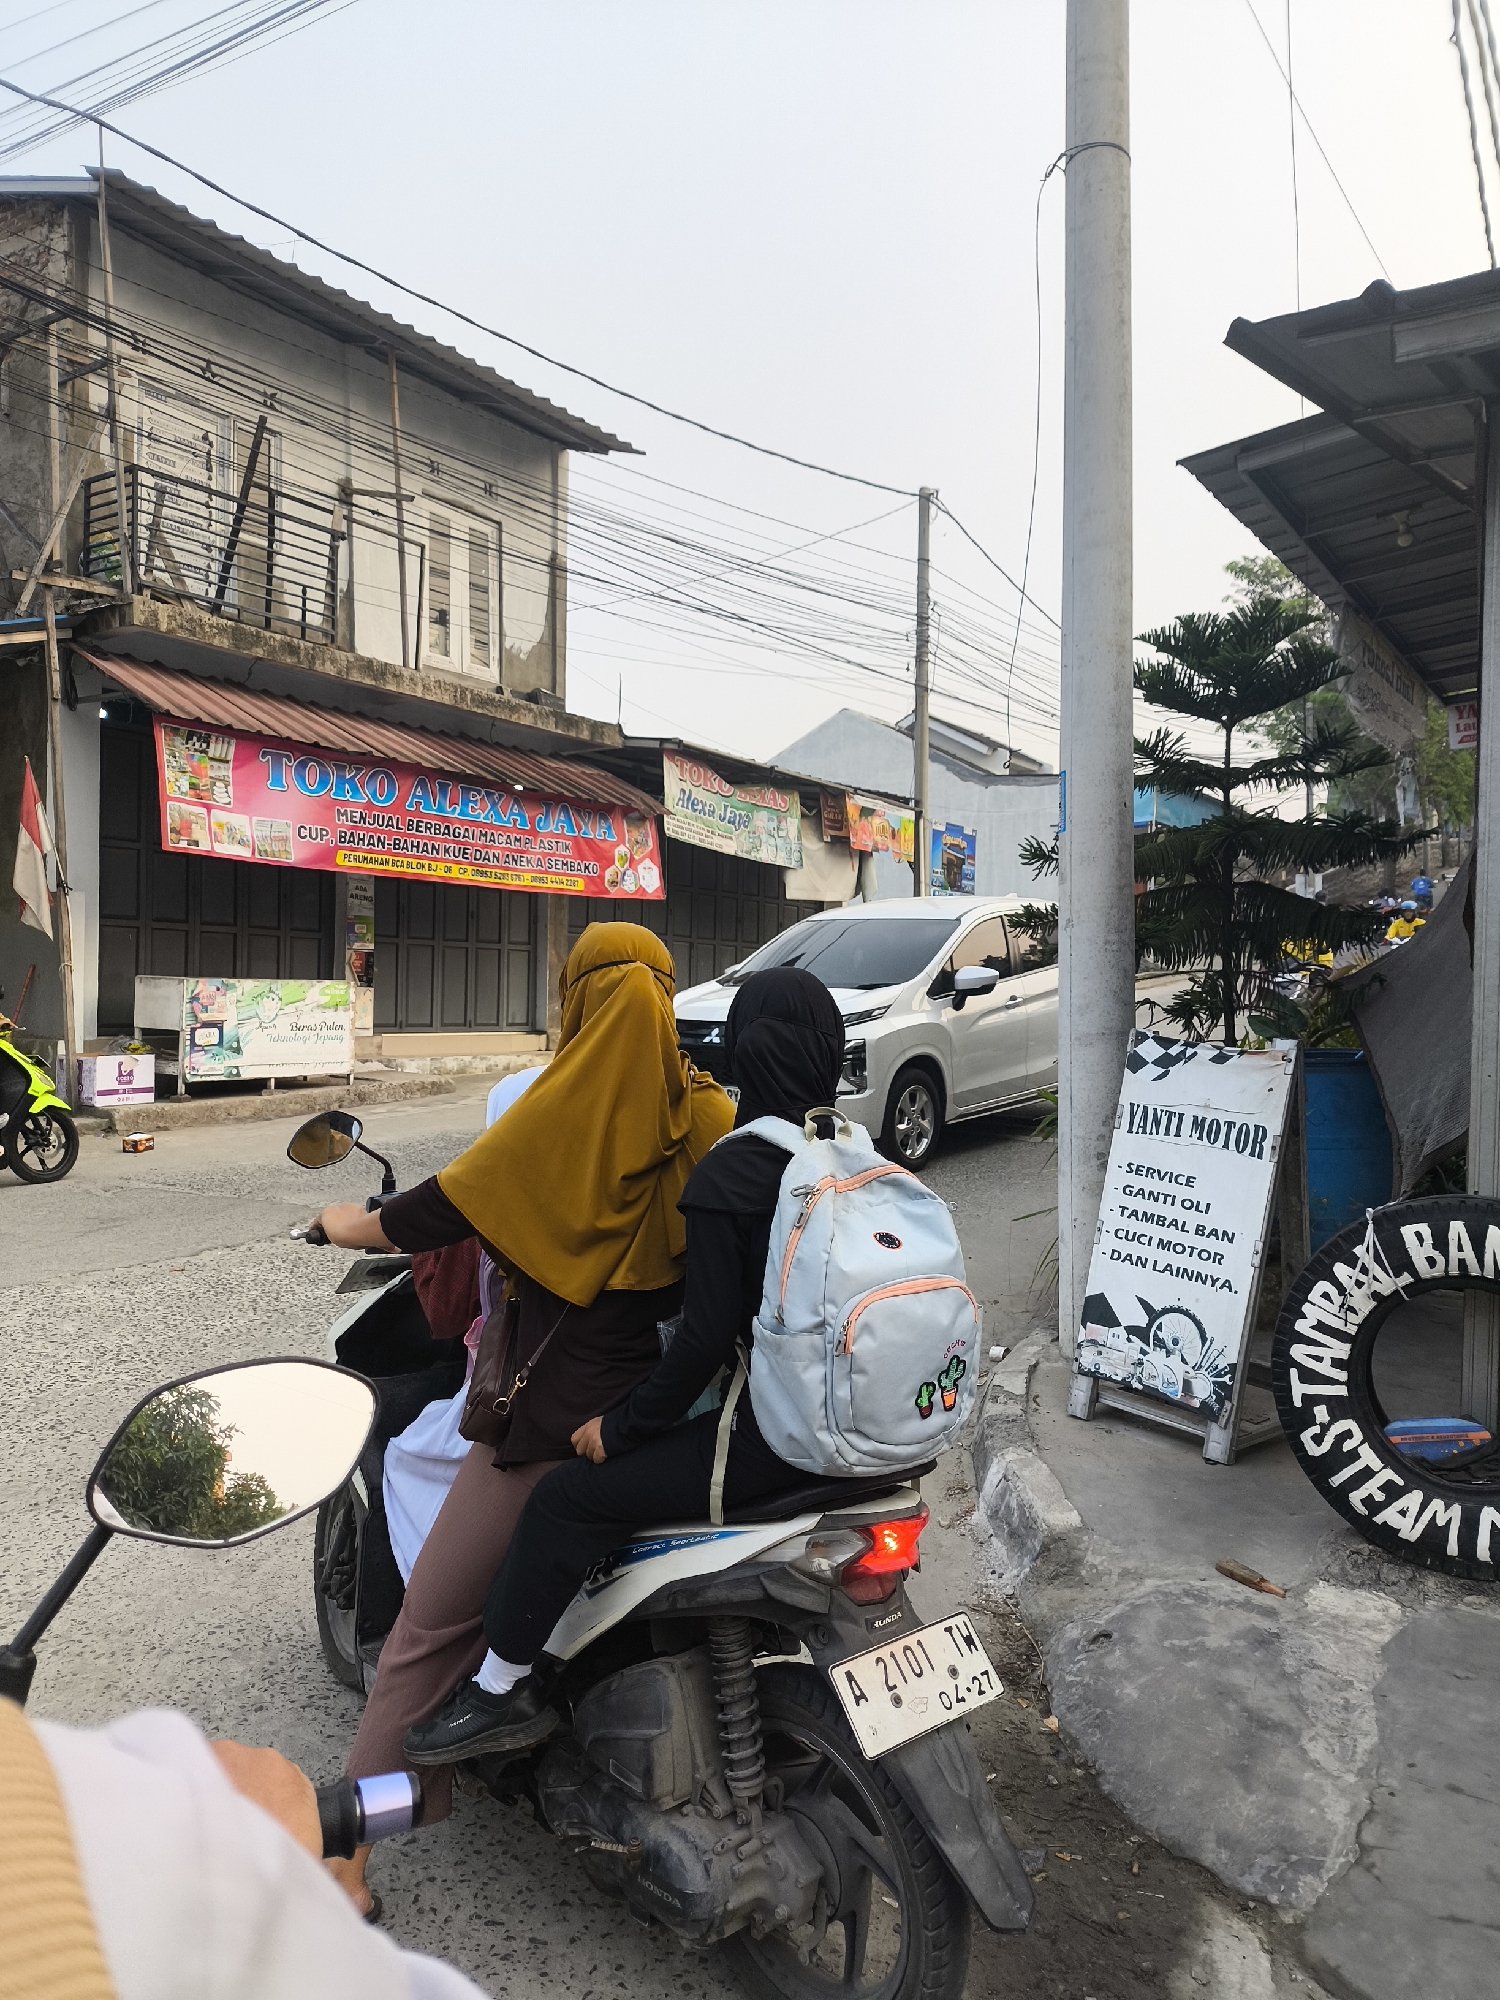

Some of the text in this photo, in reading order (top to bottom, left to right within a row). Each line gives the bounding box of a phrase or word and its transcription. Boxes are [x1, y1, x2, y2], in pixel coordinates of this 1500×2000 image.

[259, 748, 398, 807] TOKO
[406, 775, 530, 829] ALEXA
[536, 800, 617, 841] JAYA
[676, 787, 717, 819] Alexa
[718, 802, 751, 831] Jaya
[336, 808, 572, 854] MENJUAL BERBAGAI MACAM PLASTIK
[338, 829, 440, 856] BAHAN-BAHAN
[444, 842, 471, 860] KUE
[474, 848, 500, 865] DAN
[503, 852, 544, 869] ANEKA
[547, 857, 599, 875] SEMBAKO
[343, 853, 390, 867] PERUMAHAN
[405, 860, 426, 871] BLOK
[267, 1033, 311, 1045] Teknologi
[289, 1022, 318, 1032] Beras
[1126, 1102, 1268, 1161] YANTI MOTOR
[1125, 1162, 1197, 1189] SERVICE
[1122, 1184, 1177, 1207] GANTI
[1180, 1197, 1211, 1216] OLI
[1118, 1205, 1190, 1233] TAMBAL
[1194, 1222, 1236, 1244] BAN
[1110, 1249, 1148, 1271] DAN
[1114, 1227, 1153, 1248] CUCI
[1156, 1239, 1225, 1267] MOTOR
[1290, 1244, 1415, 1408] TAMBAL
[1300, 1418, 1461, 1557] STEAM
[844, 1620, 979, 1707] A 2101 TW
[638, 1875, 682, 1909] HONDA
